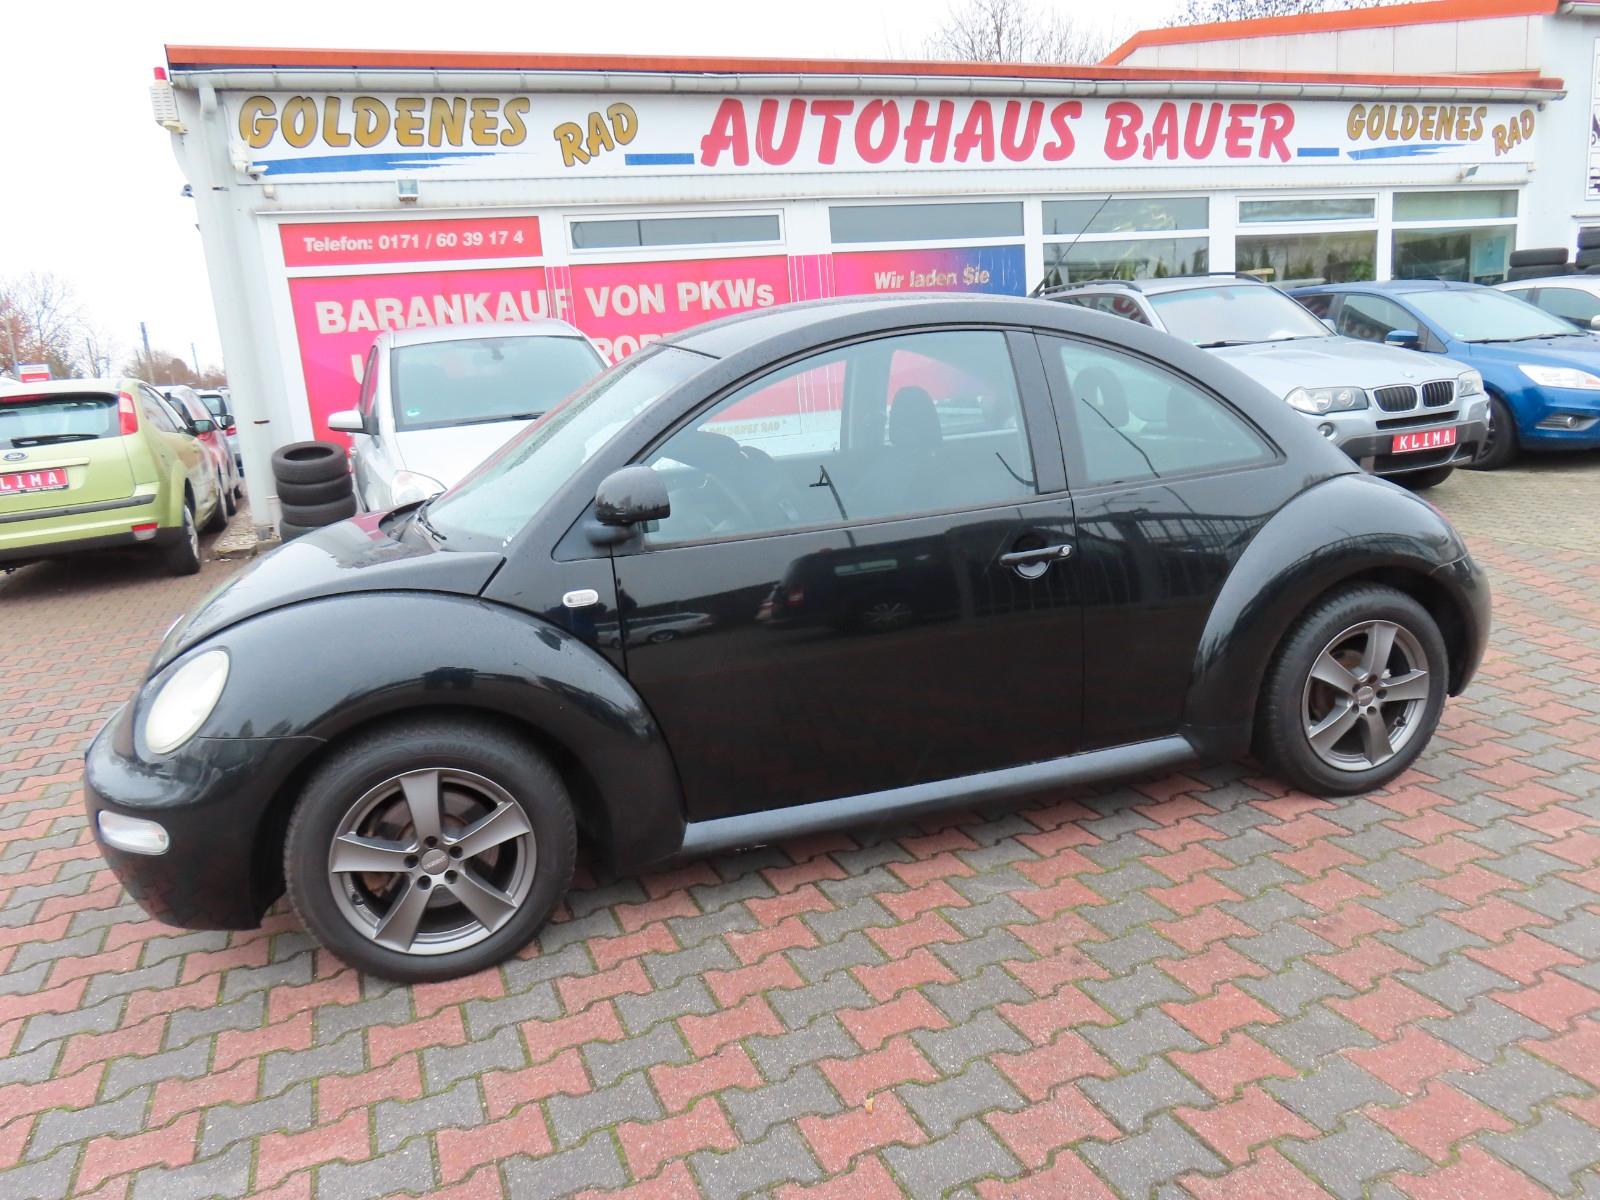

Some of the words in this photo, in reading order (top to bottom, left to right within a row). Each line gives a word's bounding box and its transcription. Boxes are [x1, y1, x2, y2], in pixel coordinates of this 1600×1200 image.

[238, 96, 530, 148] GOLDENES
[554, 102, 638, 167] RAD
[700, 98, 1082, 167] AUTOHAUS
[1103, 101, 1295, 163] BAUER
[1347, 103, 1487, 141] GOLDENES
[1492, 109, 1534, 156] RAD
[304, 235, 373, 252] Telefon:
[378, 234, 420, 250] 0171
[425, 233, 432, 249] /
[436, 232, 457, 247] 60
[463, 231, 484, 246] 39
[489, 230, 508, 245] 17
[513, 230, 524, 244] 4
[874, 270, 904, 289] Wir
[909, 269, 958, 288] laden
[963, 264, 990, 285] Sie
[315, 288, 571, 335] BARANKAUF
[584, 283, 666, 318] VON
[677, 277, 775, 312] PKWs
[1400, 430, 1451, 450] KLIMA
[0, 471, 59, 490] LIMA
